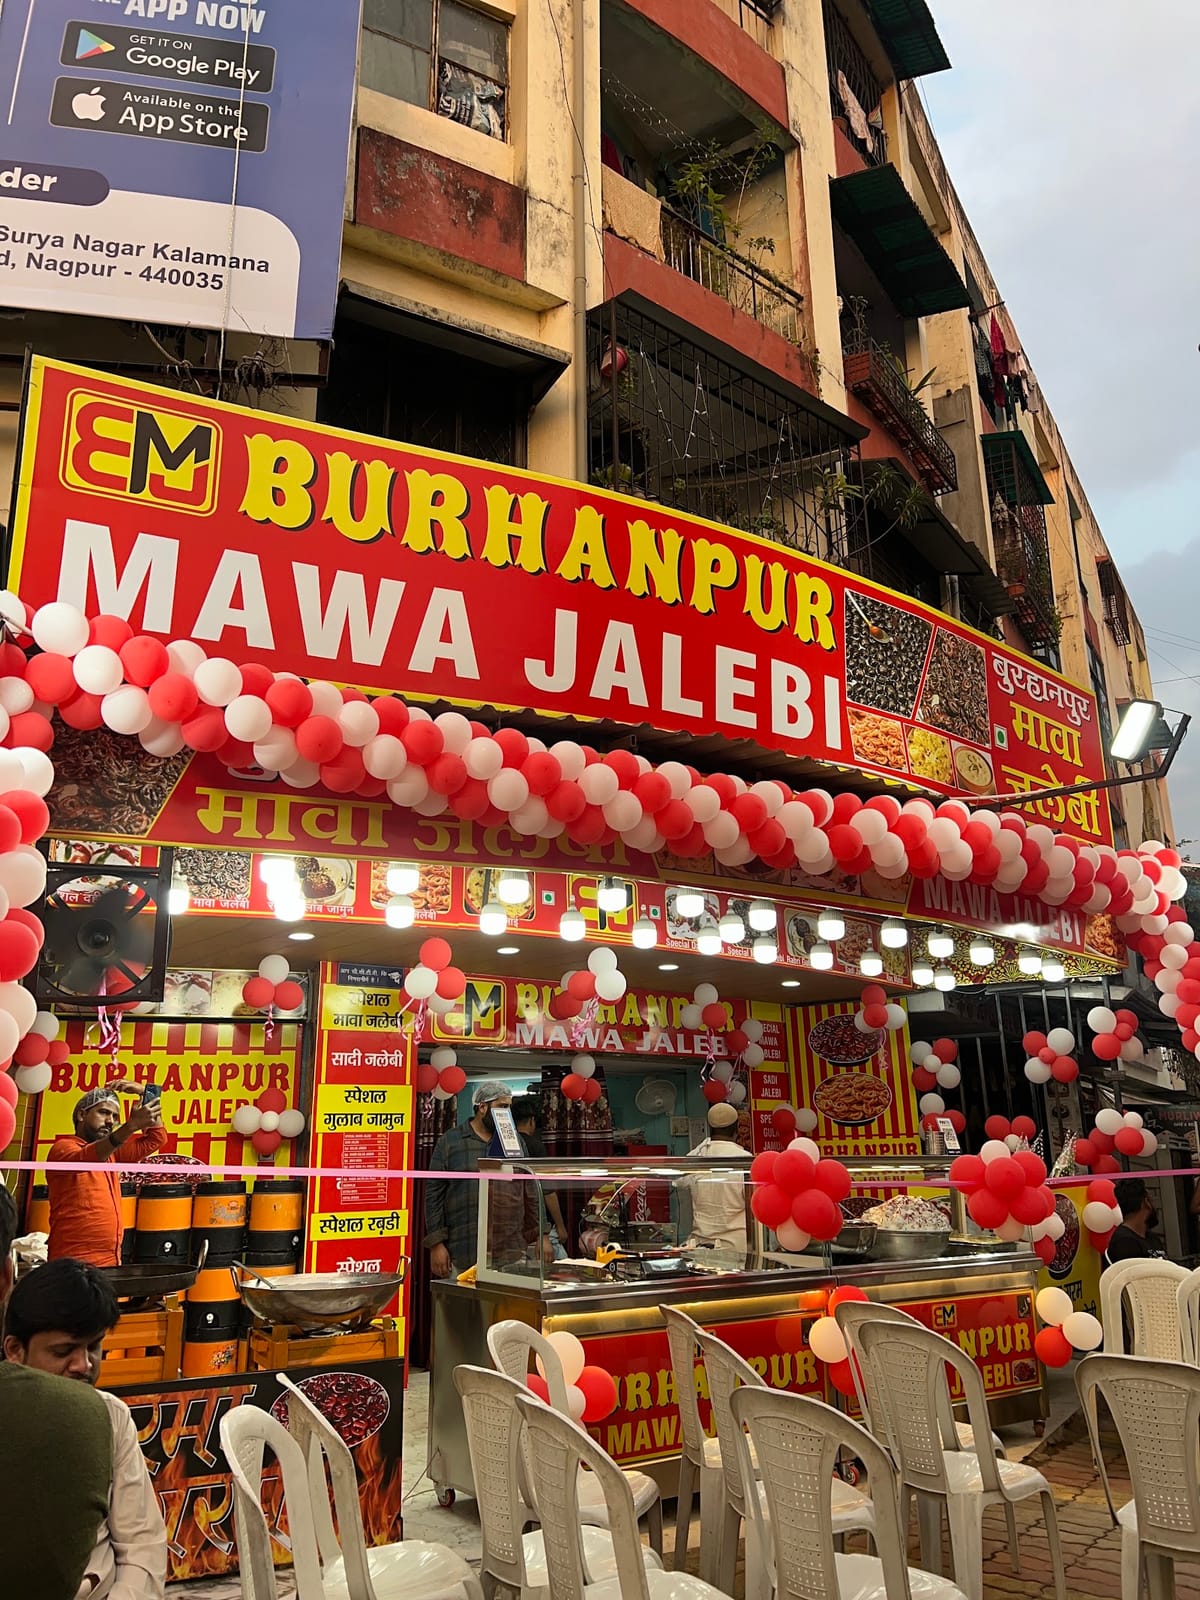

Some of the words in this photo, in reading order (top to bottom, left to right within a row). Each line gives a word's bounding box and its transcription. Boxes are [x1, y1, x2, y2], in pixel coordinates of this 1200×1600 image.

[124, 0, 188, 21] APP
[195, 2, 266, 34] NOW
[129, 34, 155, 46] GET
[158, 38, 171, 48] IT
[172, 40, 193, 51] ON
[126, 47, 209, 75] Google
[214, 59, 260, 85] Play
[123, 91, 191, 111] Available
[195, 104, 212, 114] on
[218, 106, 242, 118] the
[118, 106, 174, 134] App
[179, 113, 249, 142] Store
[0, 225, 64, 250] Surya
[73, 233, 145, 258] Nagar
[152, 243, 270, 273] Kalamana
[26, 252, 117, 278] Nagpur
[139, 266, 224, 290] 440035
[238, 432, 837, 652] BURHANPUR
[56, 518, 481, 681] MAWA
[523, 607, 843, 751] JALEBI
[992, 652, 1091, 727] बुरहानपुर
[1009, 701, 1084, 768] मावा
[1001, 763, 1102, 836] जलेबी
[195, 786, 393, 848] मावा
[923, 874, 1001, 923] MAWA
[665, 937, 690, 949] Special
[727, 946, 749, 957] Special
[333, 1013, 363, 1027] मावा
[366, 1011, 404, 1028] जलेबी
[761, 1023, 780, 1034] ECIAL
[515, 1023, 626, 1050] MAWA
[636, 1031, 736, 1056] JALEB
[331, 1048, 362, 1067] सादी
[365, 1049, 404, 1068] जलेबी
[760, 1087, 782, 1098] JALEBI
[762, 1074, 778, 1085] SADI
[344, 1086, 388, 1104] स्पेशल
[172, 1098, 260, 1125] JALE
[324, 1113, 363, 1131] गुलाब
[367, 1113, 405, 1131] जामुन
[819, 1142, 918, 1156] RHANPUR
[319, 1215, 364, 1234] स्पेशल
[336, 1256, 382, 1274] स्पेशल
